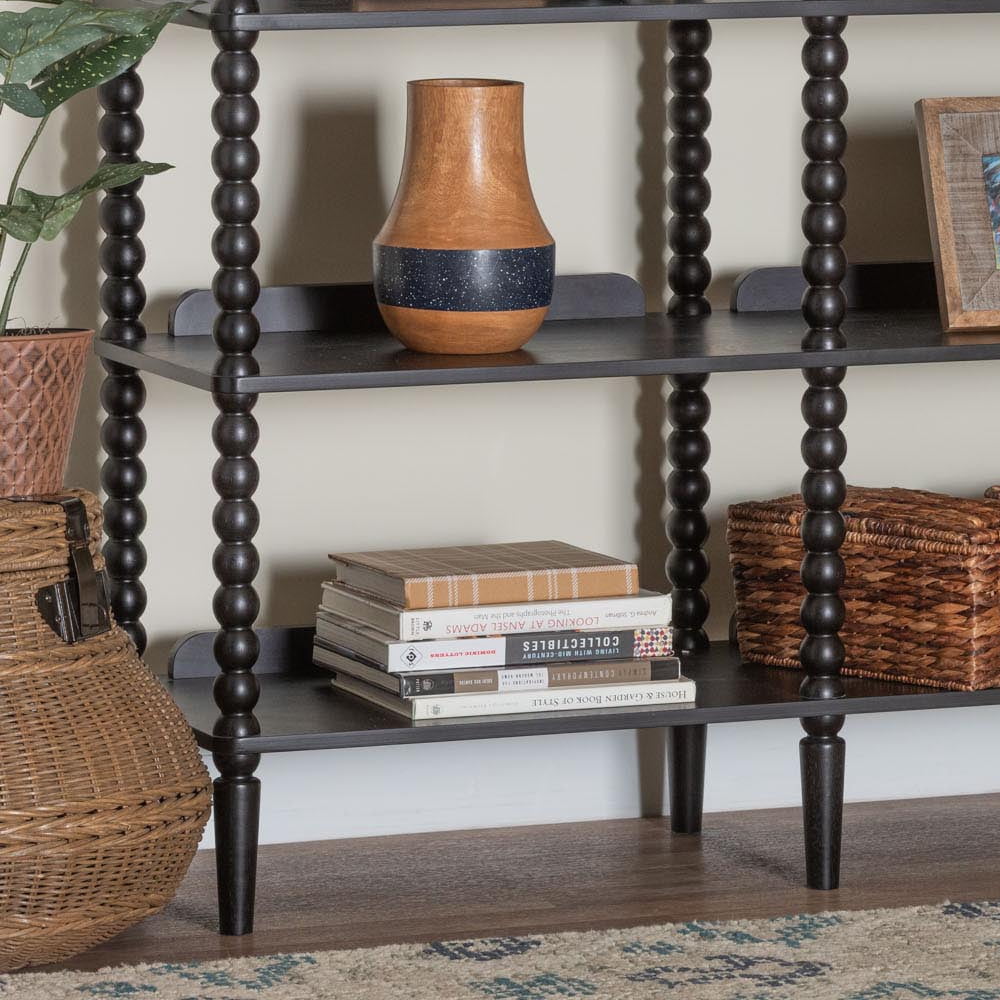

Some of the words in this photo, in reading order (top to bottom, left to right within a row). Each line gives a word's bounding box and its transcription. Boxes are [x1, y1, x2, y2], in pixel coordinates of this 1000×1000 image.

[492, 620, 526, 631] ANSEL
[530, 621, 542, 630] AT
[548, 616, 599, 629] LOOKING
[446, 623, 488, 633] ADAMS
[522, 635, 619, 652] COLLECTIBLES
[522, 650, 572, 659] MID-CENTURY
[595, 647, 619, 656] LIVING
[575, 694, 602, 703] BOOK
[605, 692, 644, 702] GARDEN
[656, 689, 687, 699] HOUSE
[531, 697, 559, 707] STYLE
[562, 696, 575, 704] OF
